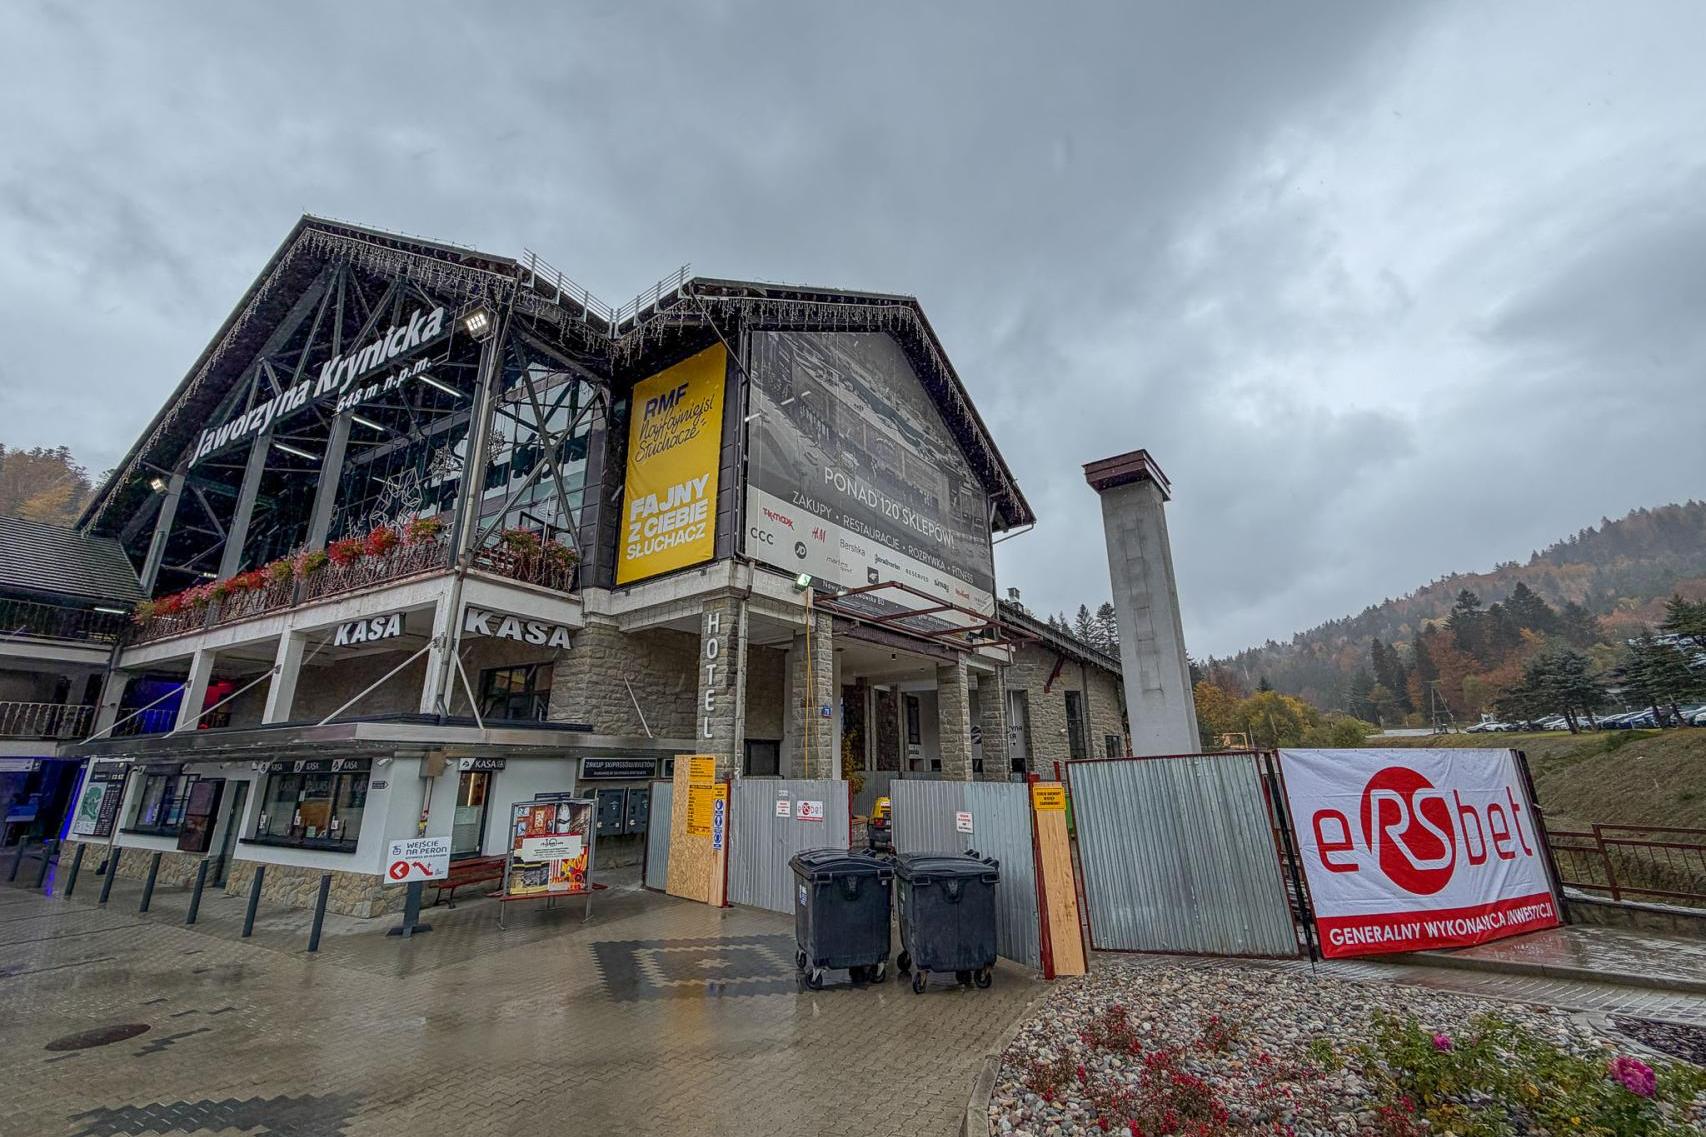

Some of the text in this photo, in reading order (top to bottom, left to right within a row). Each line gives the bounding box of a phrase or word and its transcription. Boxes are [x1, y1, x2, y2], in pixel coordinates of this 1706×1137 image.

[188, 306, 445, 468] Jaworzyna Krynicka
[336, 390, 362, 413] 648
[364, 382, 378, 399] m
[643, 382, 689, 420] RMF
[630, 473, 710, 522] FAJNY
[824, 466, 955, 550] PONAD 120 SKLEPÓW!
[627, 498, 708, 544] Z CIEBIE
[750, 527, 774, 545] CCC
[792, 490, 974, 584] ZAKUPY RESTAURACJE ROZRYWKA FITNESS
[839, 538, 866, 557] Bershka
[333, 613, 401, 647] KASA
[464, 606, 572, 650] KASA
[703, 612, 720, 738] HOTEL
[475, 759, 497, 768] KASA
[406, 840, 439, 849] WEJŚCIE
[1329, 902, 1553, 946] GENERALNY WYKONAWCA INWESTYCJI
